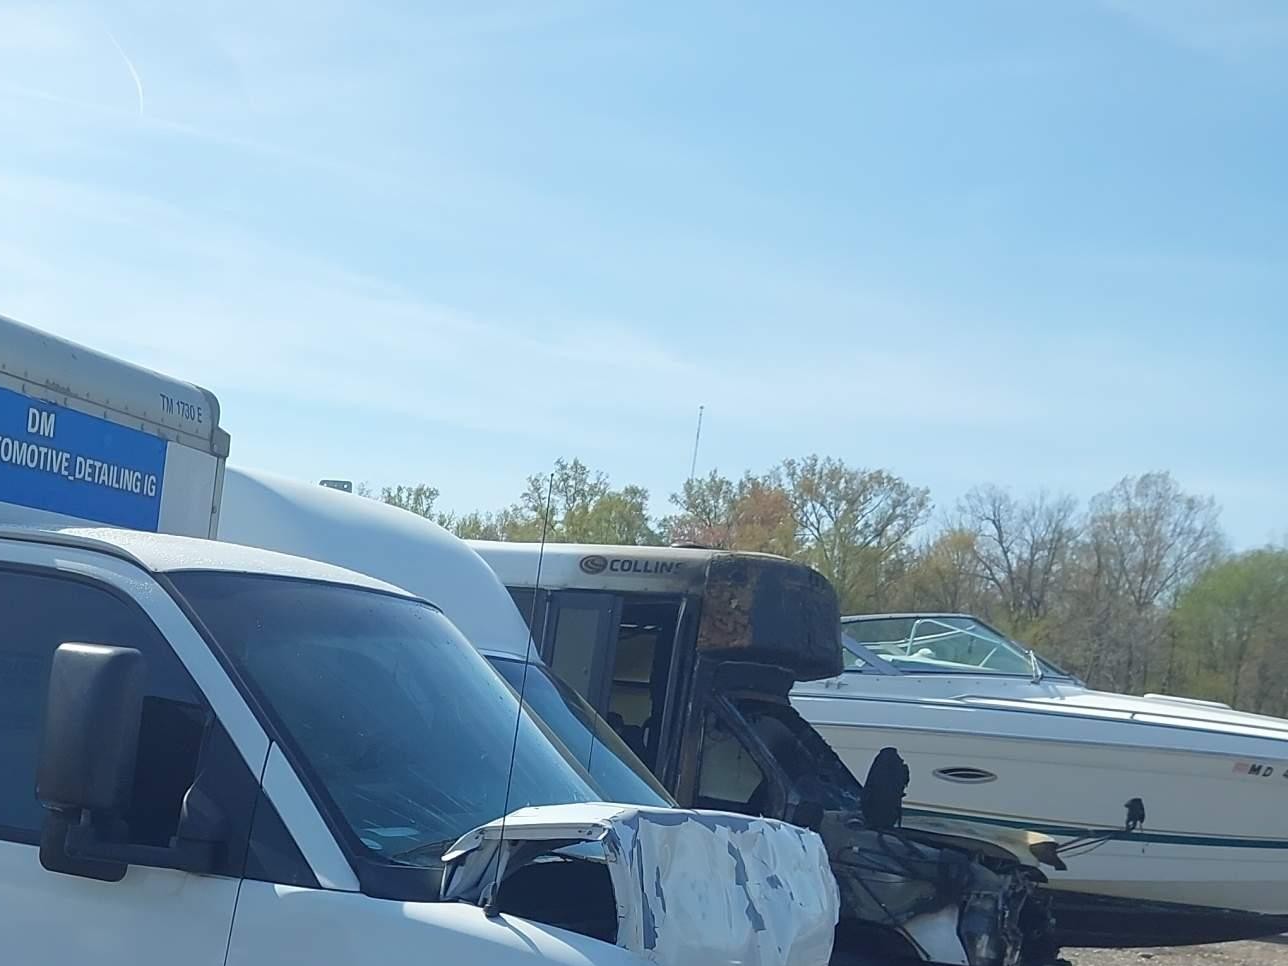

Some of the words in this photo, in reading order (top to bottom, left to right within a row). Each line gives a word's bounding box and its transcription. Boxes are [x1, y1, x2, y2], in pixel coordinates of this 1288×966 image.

[27, 408, 56, 438] DM
[159, 393, 174, 415] TM
[176, 400, 196, 421] 1730
[197, 406, 203, 424] E
[143, 474, 157, 497] IG
